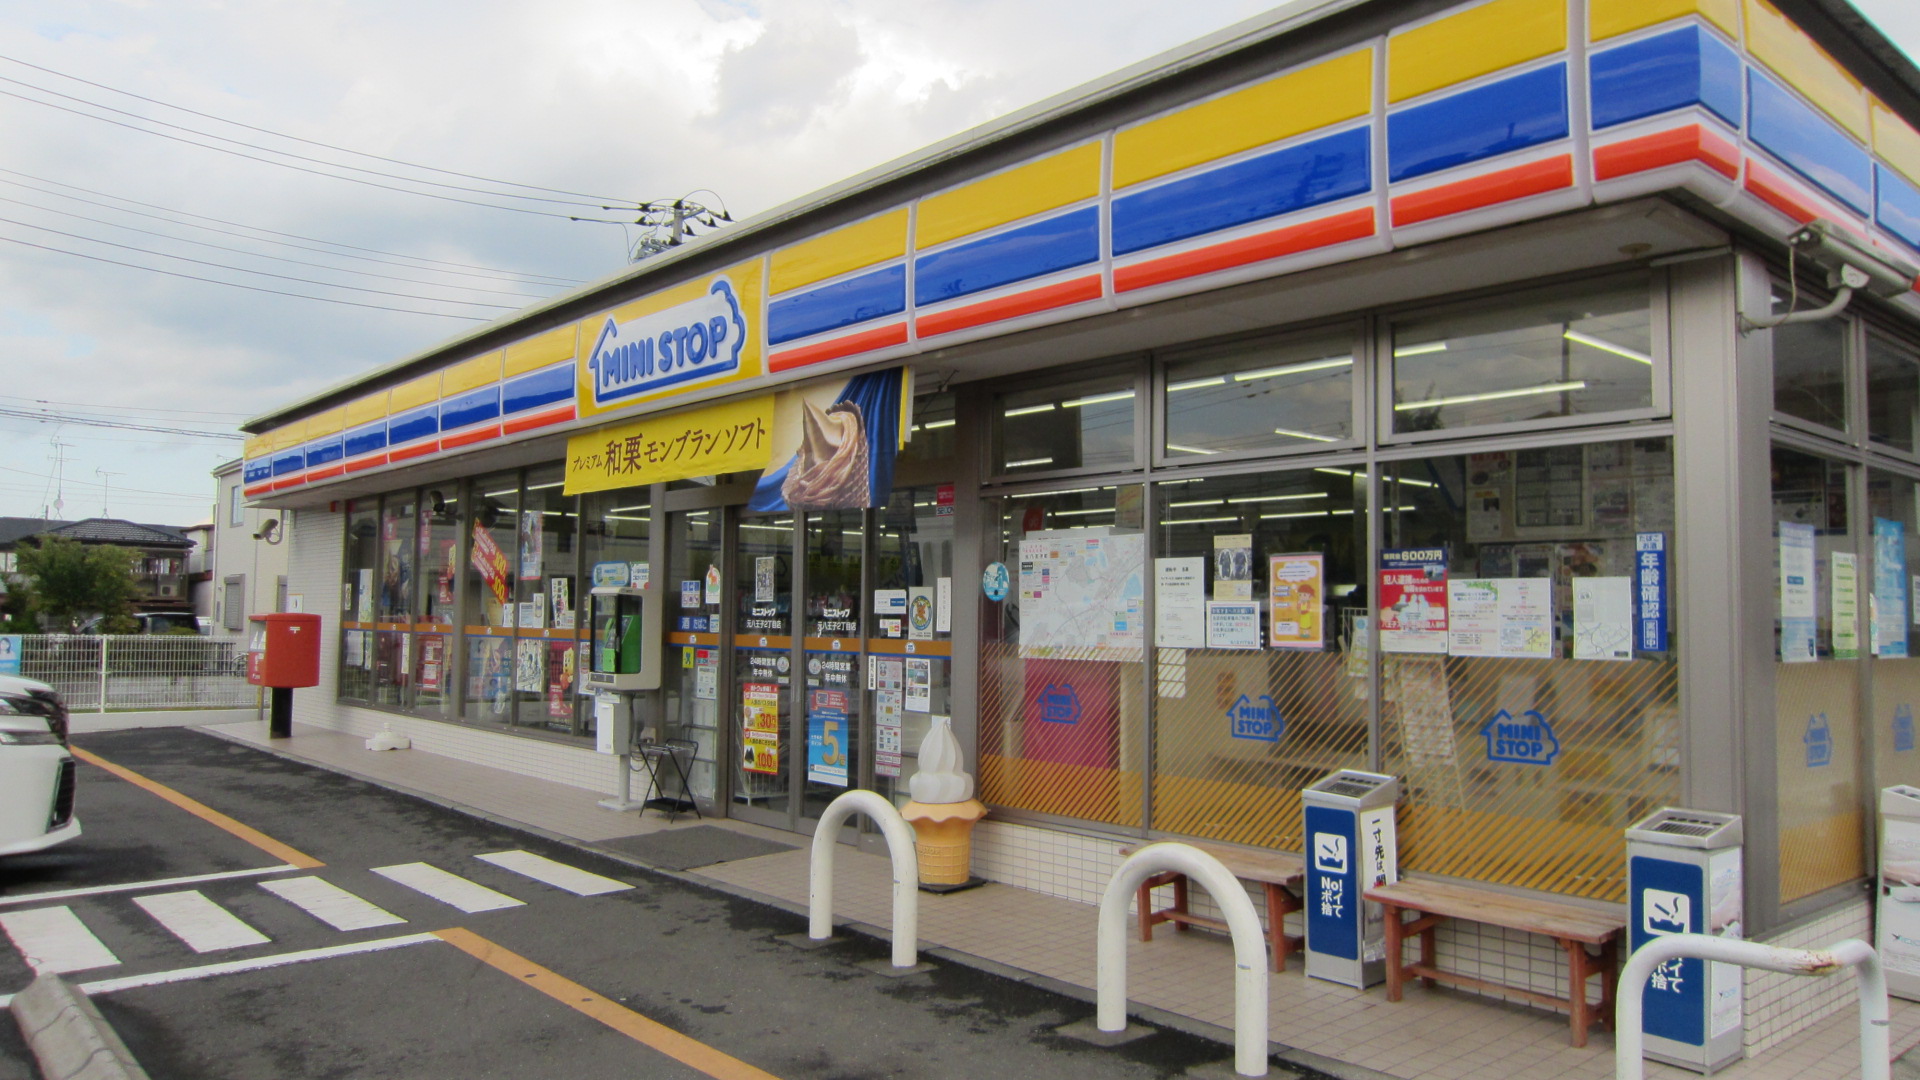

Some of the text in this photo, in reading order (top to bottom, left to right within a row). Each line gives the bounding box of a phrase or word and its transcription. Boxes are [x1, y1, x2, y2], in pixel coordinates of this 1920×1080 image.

[602, 315, 727, 387] MINI STOP
[1641, 552, 1659, 618] 年齢確認
[752, 608, 776, 617] ミニストップ
[823, 608, 850, 618] ミニストップ
[1240, 707, 1271, 720] MINI
[1238, 720, 1272, 734] STOP
[1497, 723, 1541, 740] MINI
[1496, 739, 1543, 757] STOP
[1321, 876, 1343, 892] No!
[1321, 890, 1343, 904] ポイ
[1321, 902, 1343, 918] 捨て
[1652, 972, 1684, 993] 捨て
